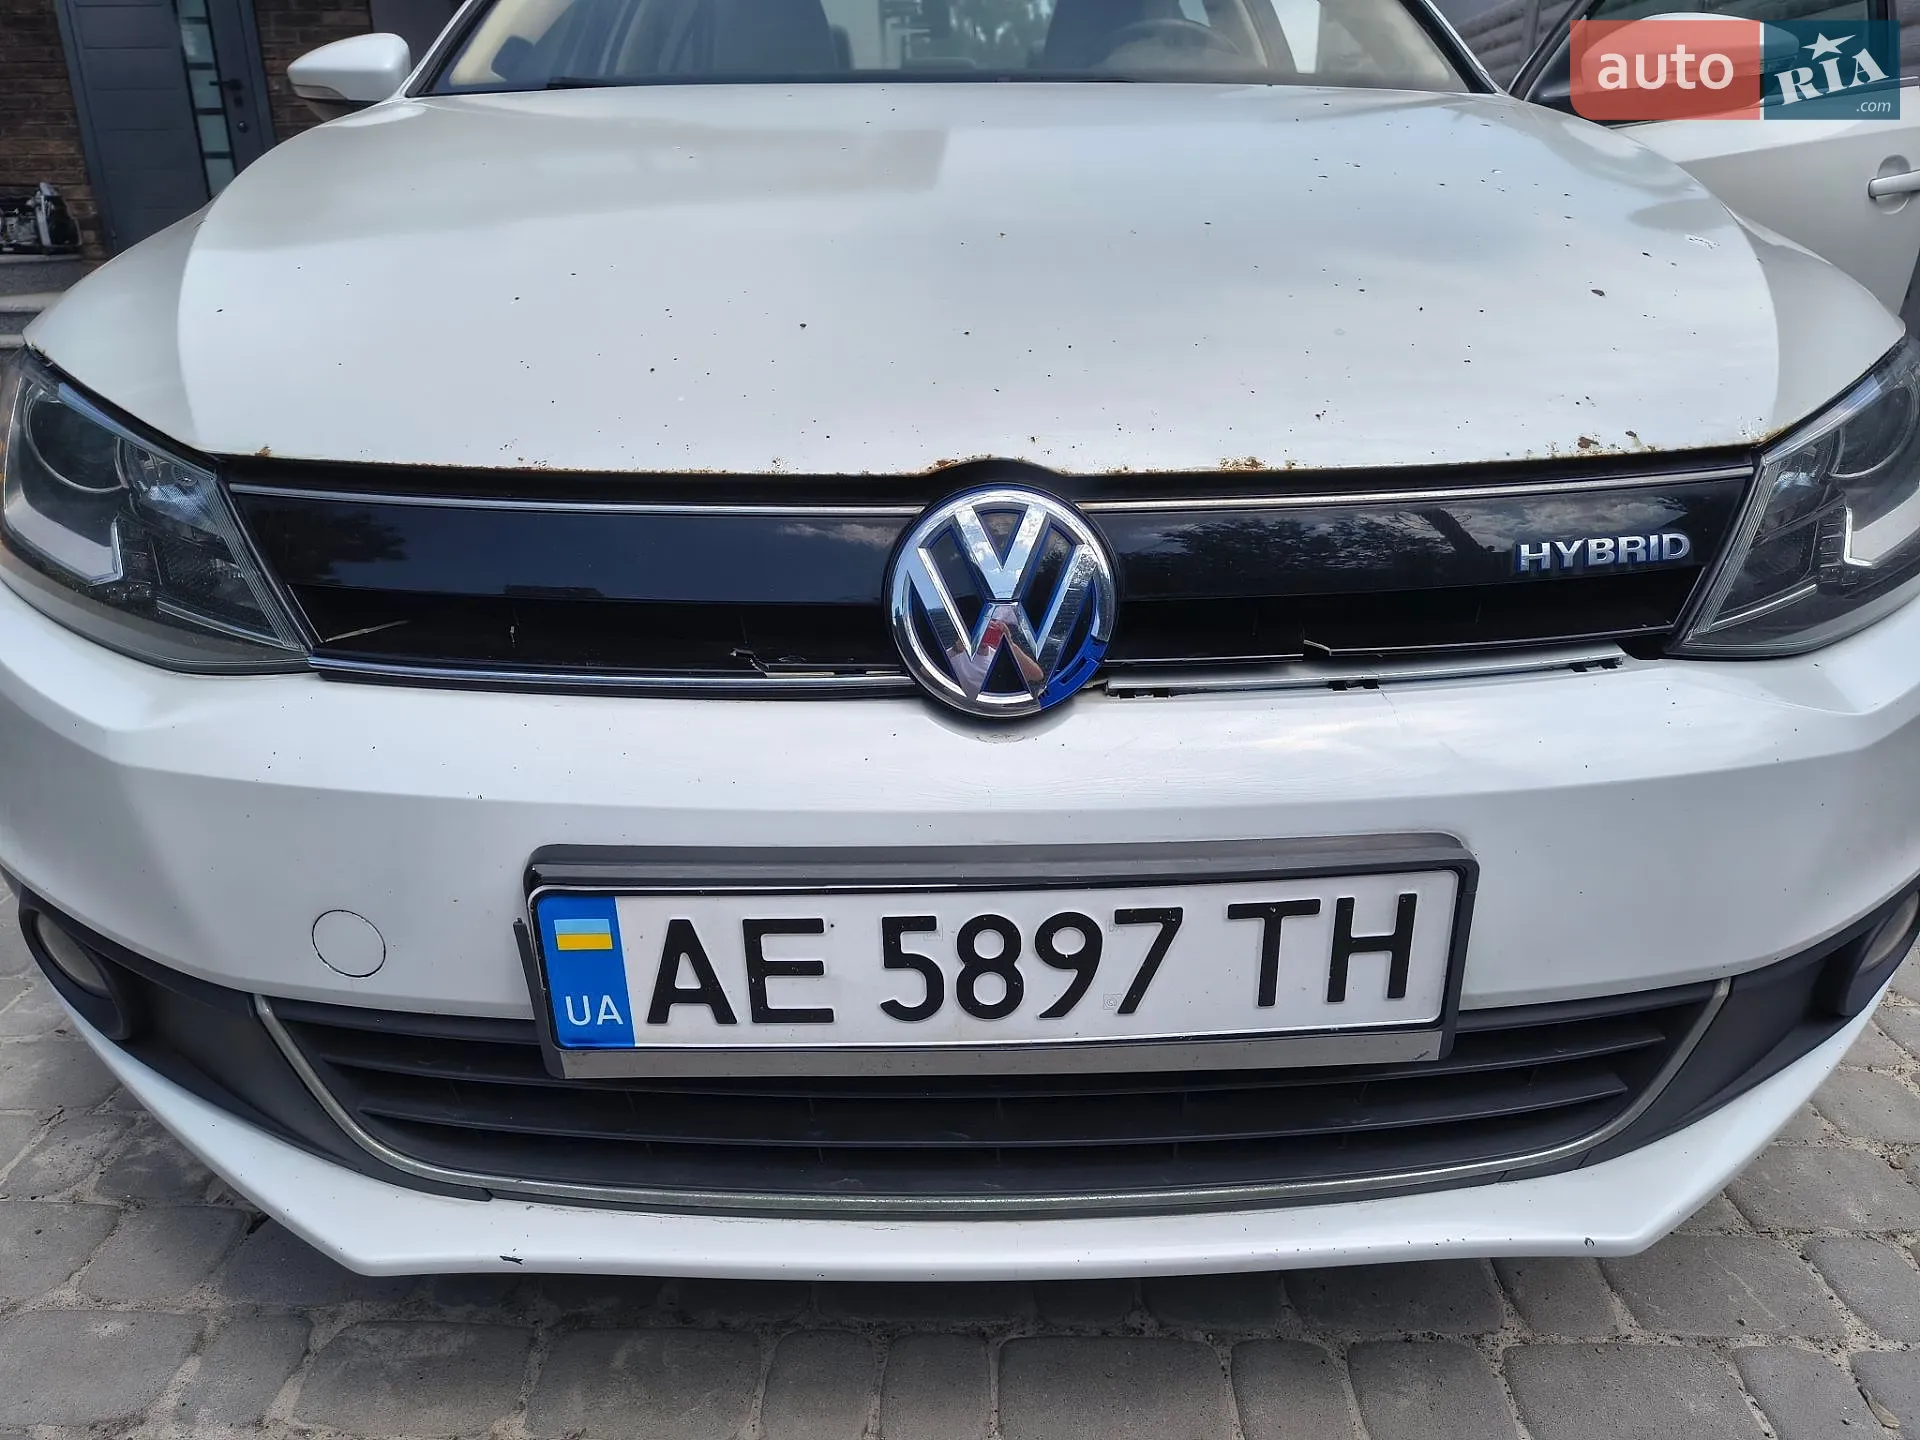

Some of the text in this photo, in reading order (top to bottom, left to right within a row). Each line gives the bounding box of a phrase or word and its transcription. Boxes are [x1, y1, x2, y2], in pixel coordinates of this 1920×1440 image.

[1517, 532, 1691, 573] HYBRID
[889, 489, 1115, 710] VW
[646, 892, 1418, 1025] AE 5897 TH
[564, 994, 624, 1027] UA
